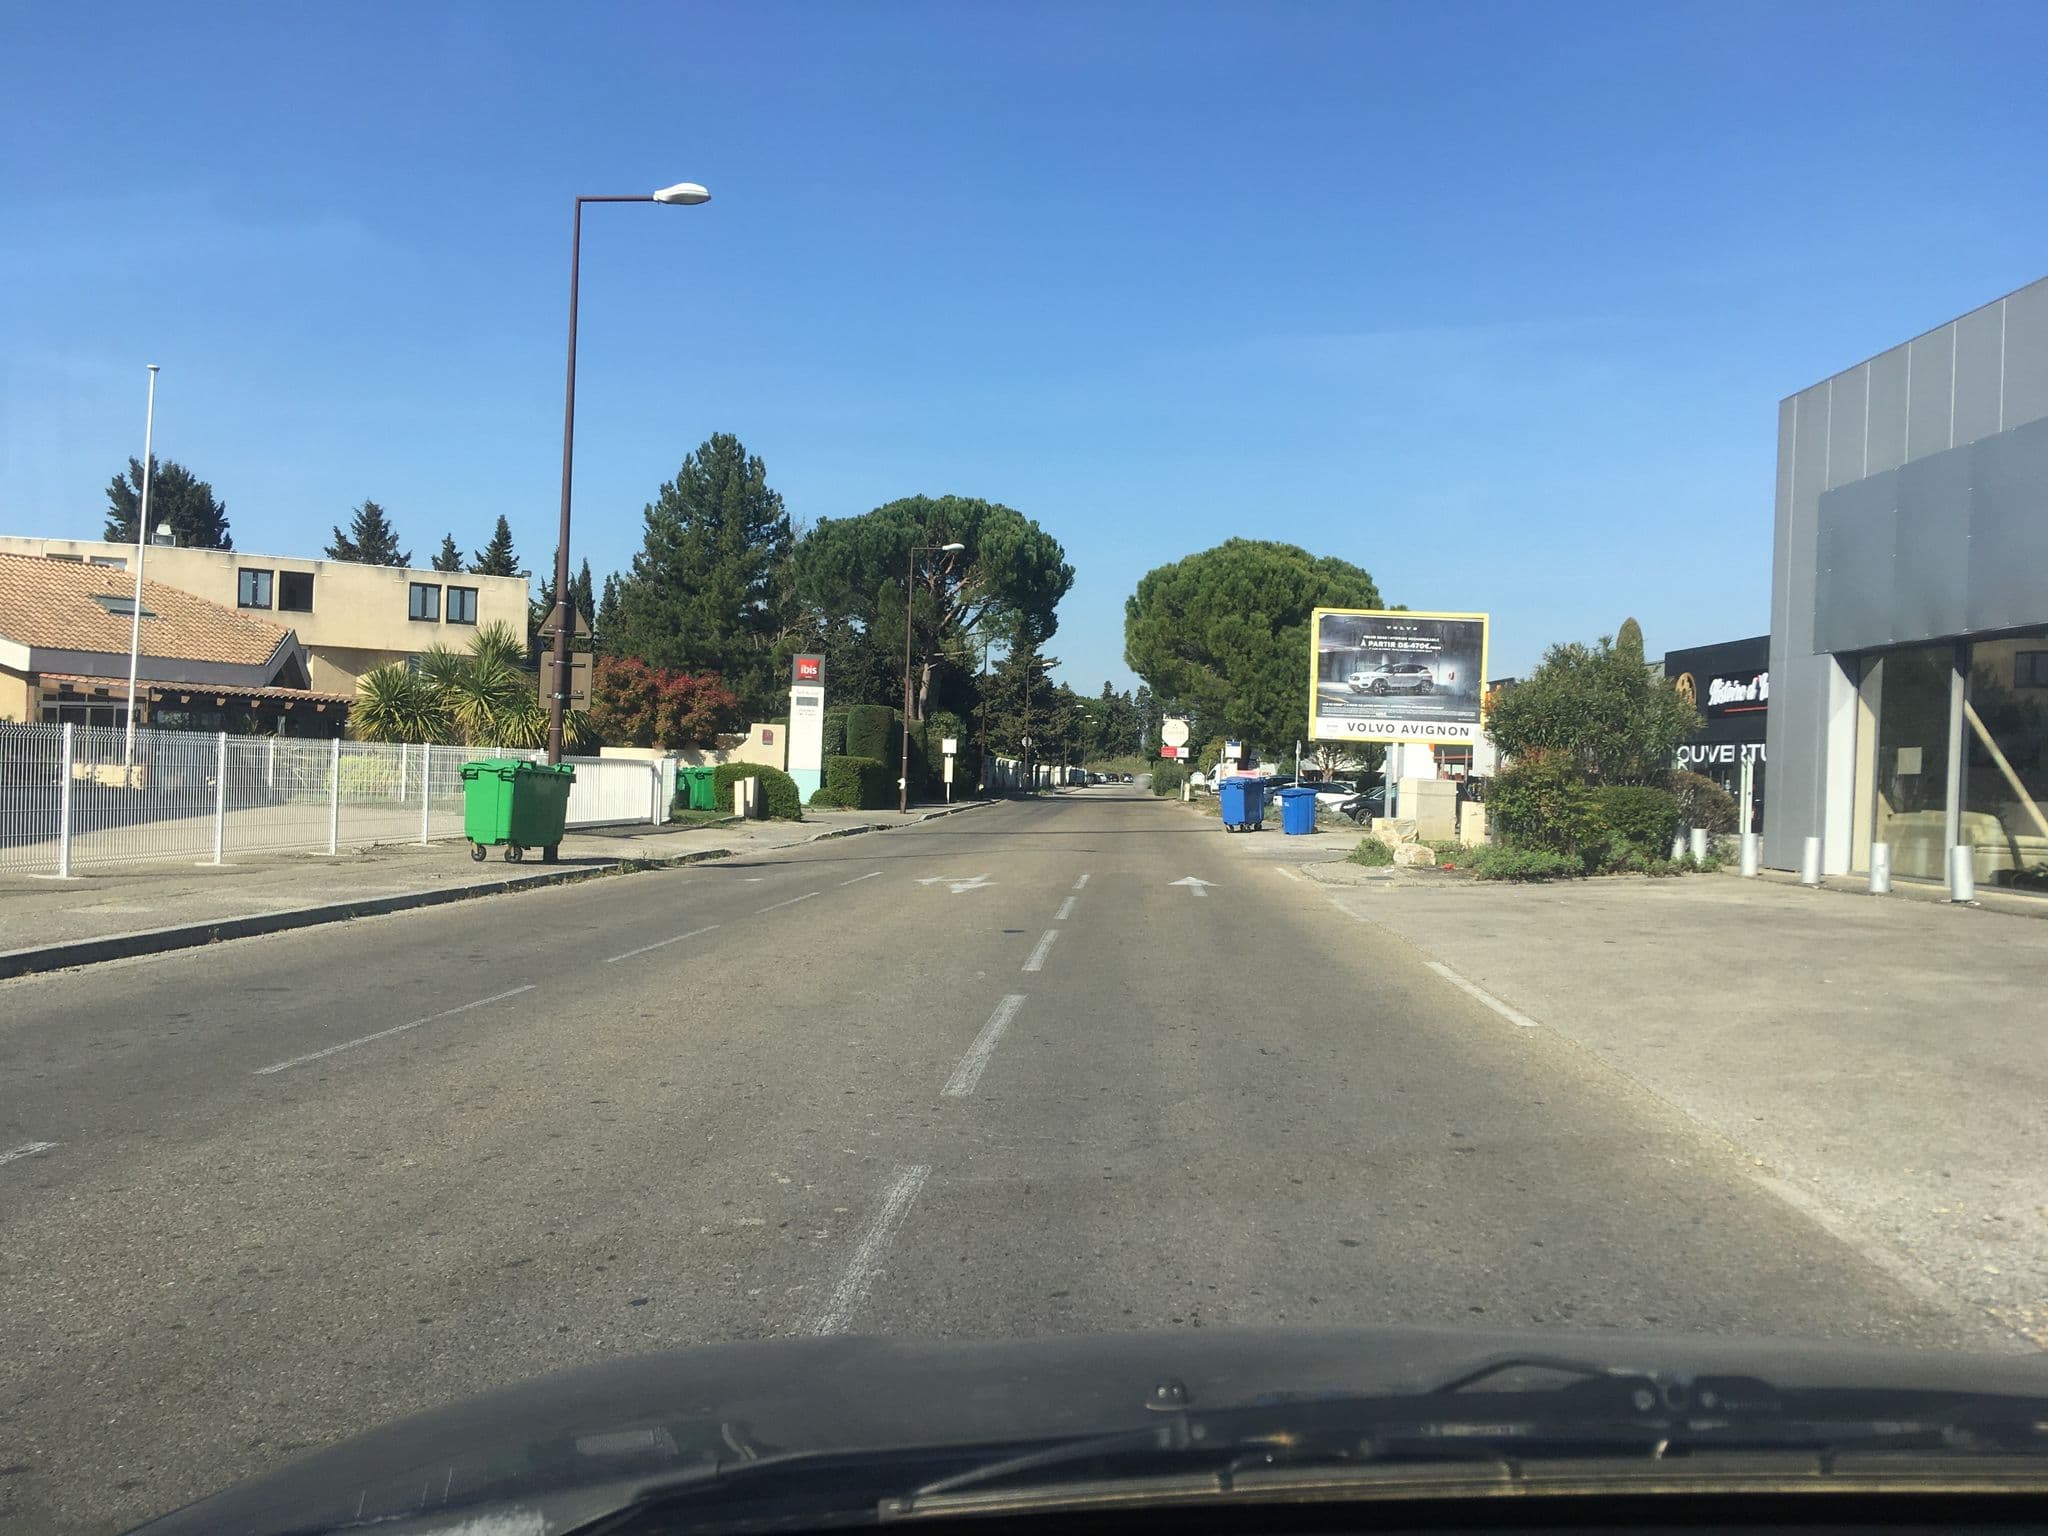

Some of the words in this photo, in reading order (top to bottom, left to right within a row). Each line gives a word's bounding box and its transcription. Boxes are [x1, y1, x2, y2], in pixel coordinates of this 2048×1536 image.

[1368, 640, 1396, 648] PARTIR
[800, 665, 817, 675] ibis
[1347, 722, 1395, 734] VOLVO
[1401, 724, 1470, 737] AVIGNON
